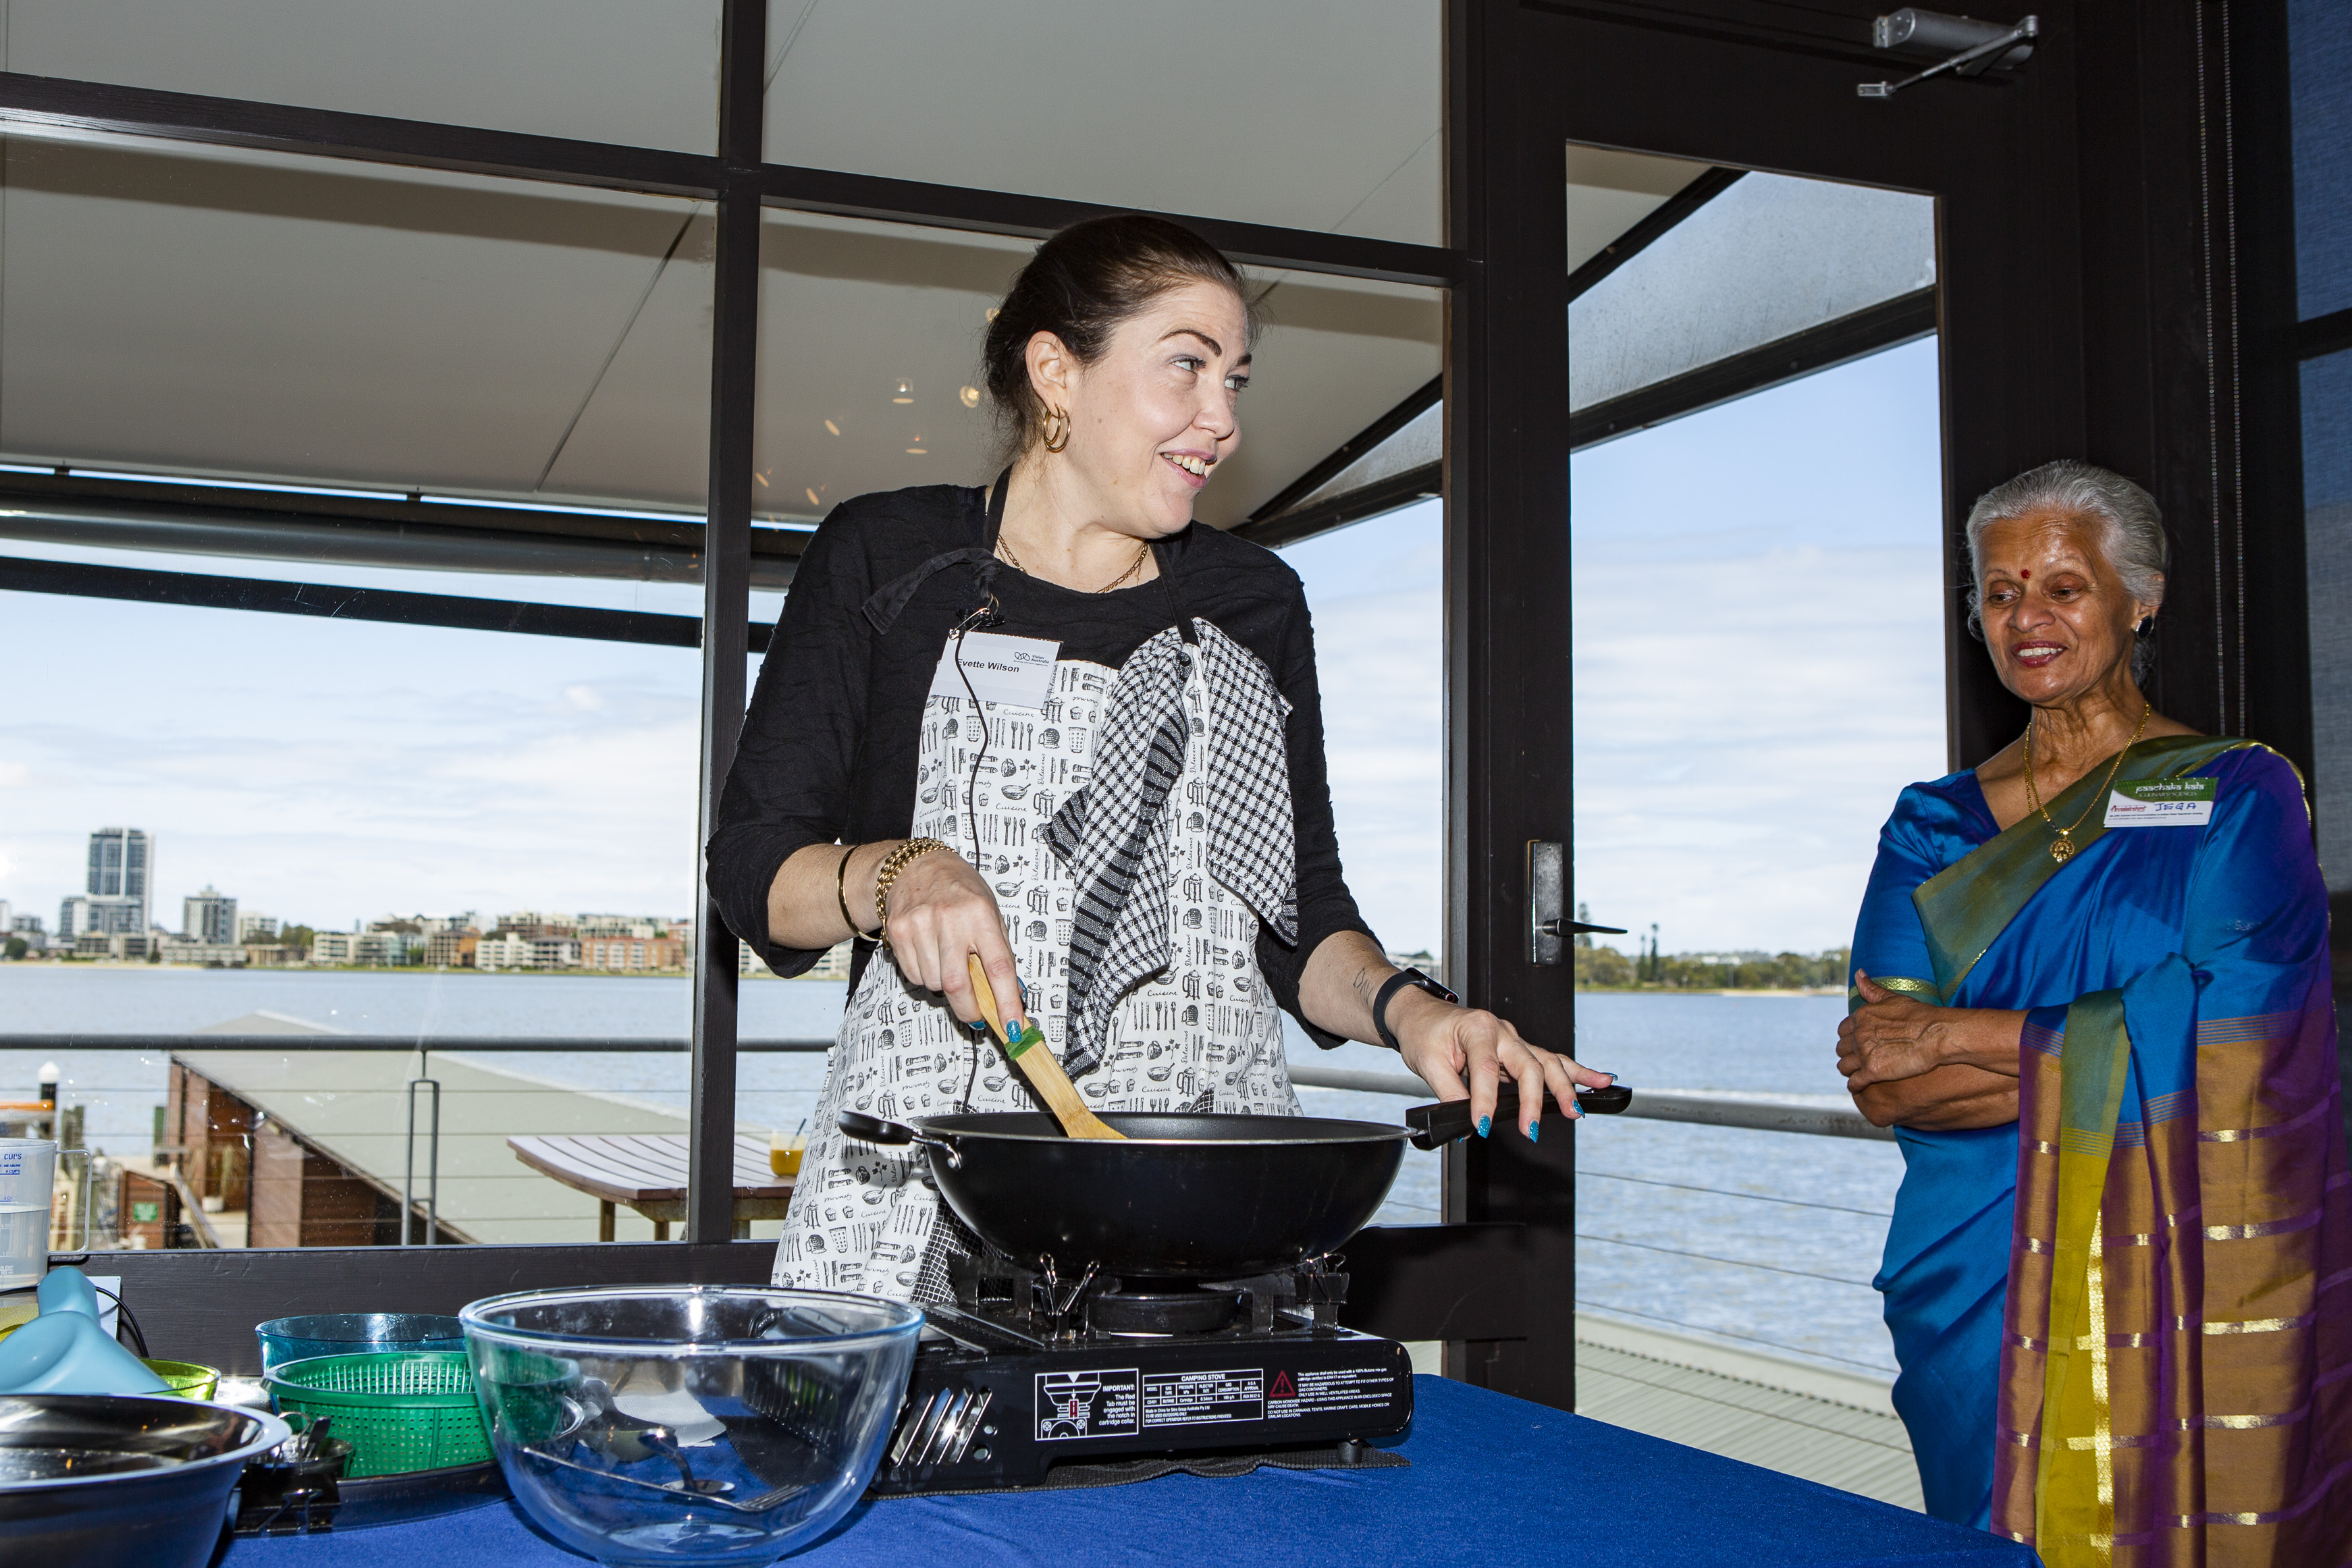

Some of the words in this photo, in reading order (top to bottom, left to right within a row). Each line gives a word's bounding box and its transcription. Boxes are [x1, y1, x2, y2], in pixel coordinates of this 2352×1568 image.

[988, 662, 1019, 673] Wilson
[1003, 709, 1034, 717] Cuisine
[2185, 782, 2205, 790] kala
[996, 803, 1027, 812] Cuisine
[2155, 802, 2196, 811] JEGA
[978, 1095, 1006, 1104] Cuisine
[861, 1210, 887, 1218] Cuisine
